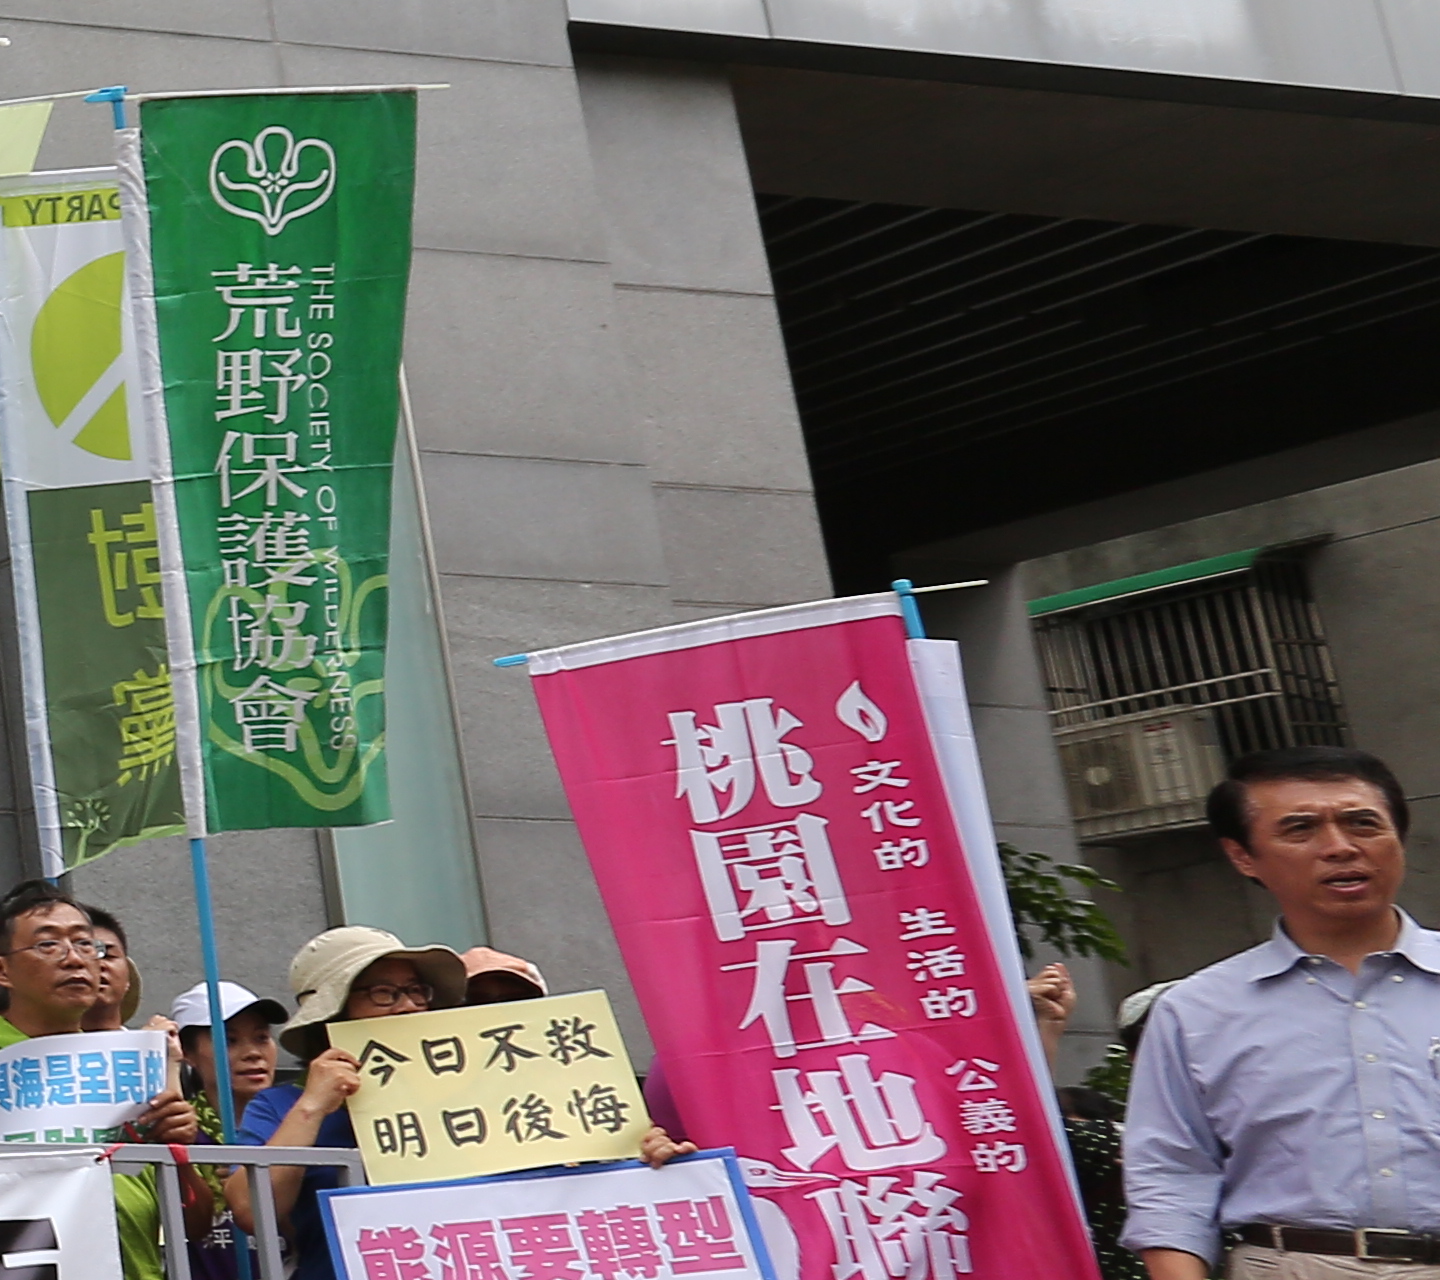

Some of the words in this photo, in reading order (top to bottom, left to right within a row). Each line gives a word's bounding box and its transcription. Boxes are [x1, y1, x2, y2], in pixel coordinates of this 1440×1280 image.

[310, 262, 336, 320] THE
[308, 331, 336, 480] SOCIETY
[212, 262, 319, 756] 荒野保護協會
[315, 488, 340, 531] OF
[320, 542, 354, 752] WILDERNESS
[850, 759, 929, 872] 文化的
[898, 906, 977, 1022] 生活的
[944, 1056, 1028, 1176] 公義的
[358, 1016, 614, 1089] 今日不救
[373, 1083, 630, 1160] 明日後悔
